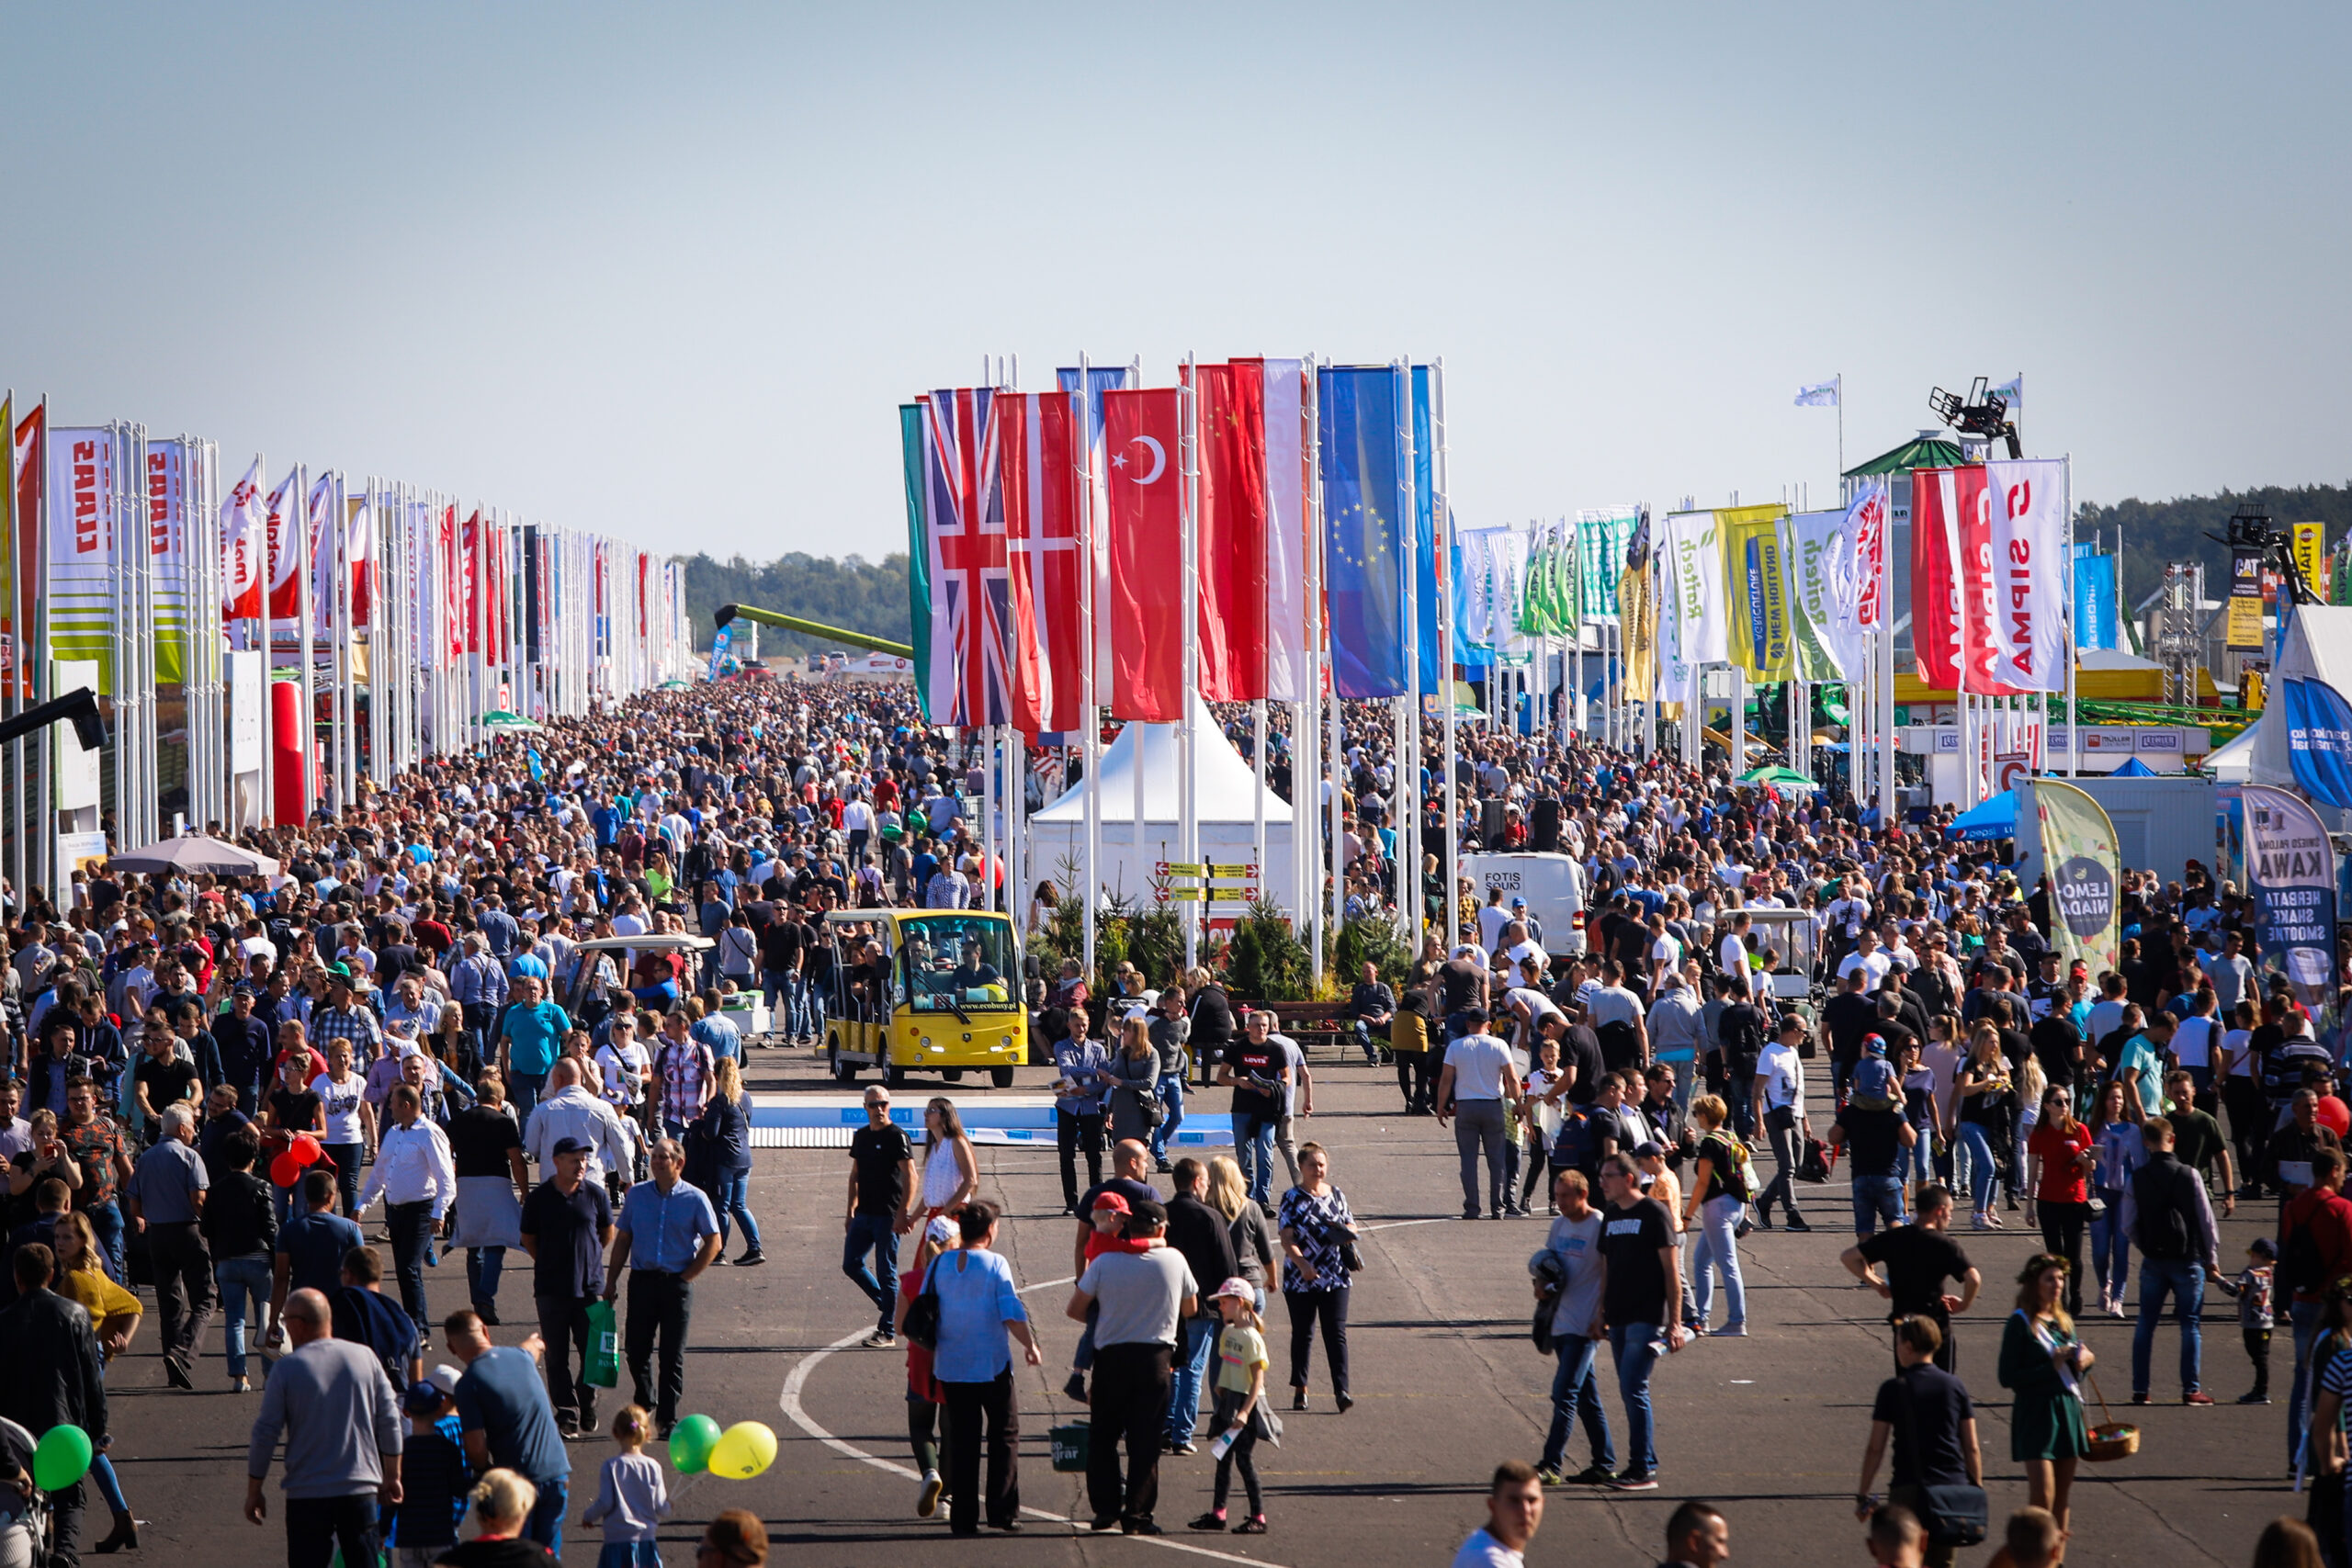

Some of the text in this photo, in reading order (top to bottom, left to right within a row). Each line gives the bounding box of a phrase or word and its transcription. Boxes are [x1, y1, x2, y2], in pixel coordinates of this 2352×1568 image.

[1963, 444, 1989, 461] CAT
[2235, 558, 2260, 578] CAT
[500, 691, 508, 710] D
[2142, 735, 2176, 746] LECHLER
[1969, 828, 1996, 839] pepsi
[1485, 872, 1521, 882] FOTIS
[1485, 883, 1521, 891] SOUND
[959, 1001, 1017, 1011] www.ecobusy.pl
[1605, 1219, 1643, 1236] PUMA
